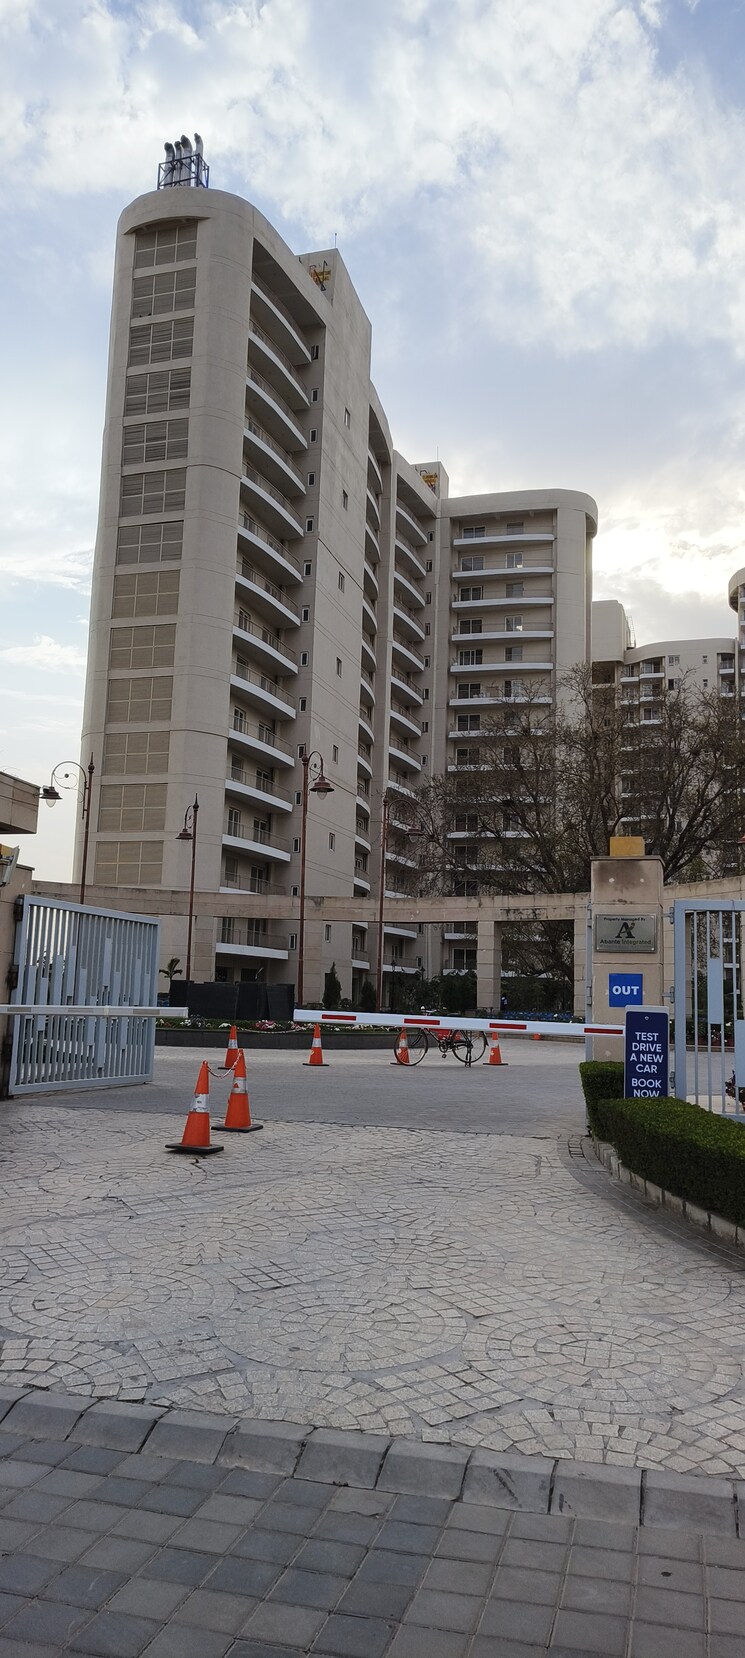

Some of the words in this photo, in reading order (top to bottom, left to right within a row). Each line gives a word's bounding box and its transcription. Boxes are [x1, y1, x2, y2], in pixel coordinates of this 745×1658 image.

[612, 986, 639, 995] OUT
[635, 1032, 659, 1041] TEST
[632, 1042, 662, 1052] DRIVE
[630, 1053, 637, 1062] A
[640, 1054, 664, 1063] NEW
[636, 1064, 657, 1073] CAR
[632, 1078, 662, 1088] BOOK
[633, 1089, 660, 1098] NOW
